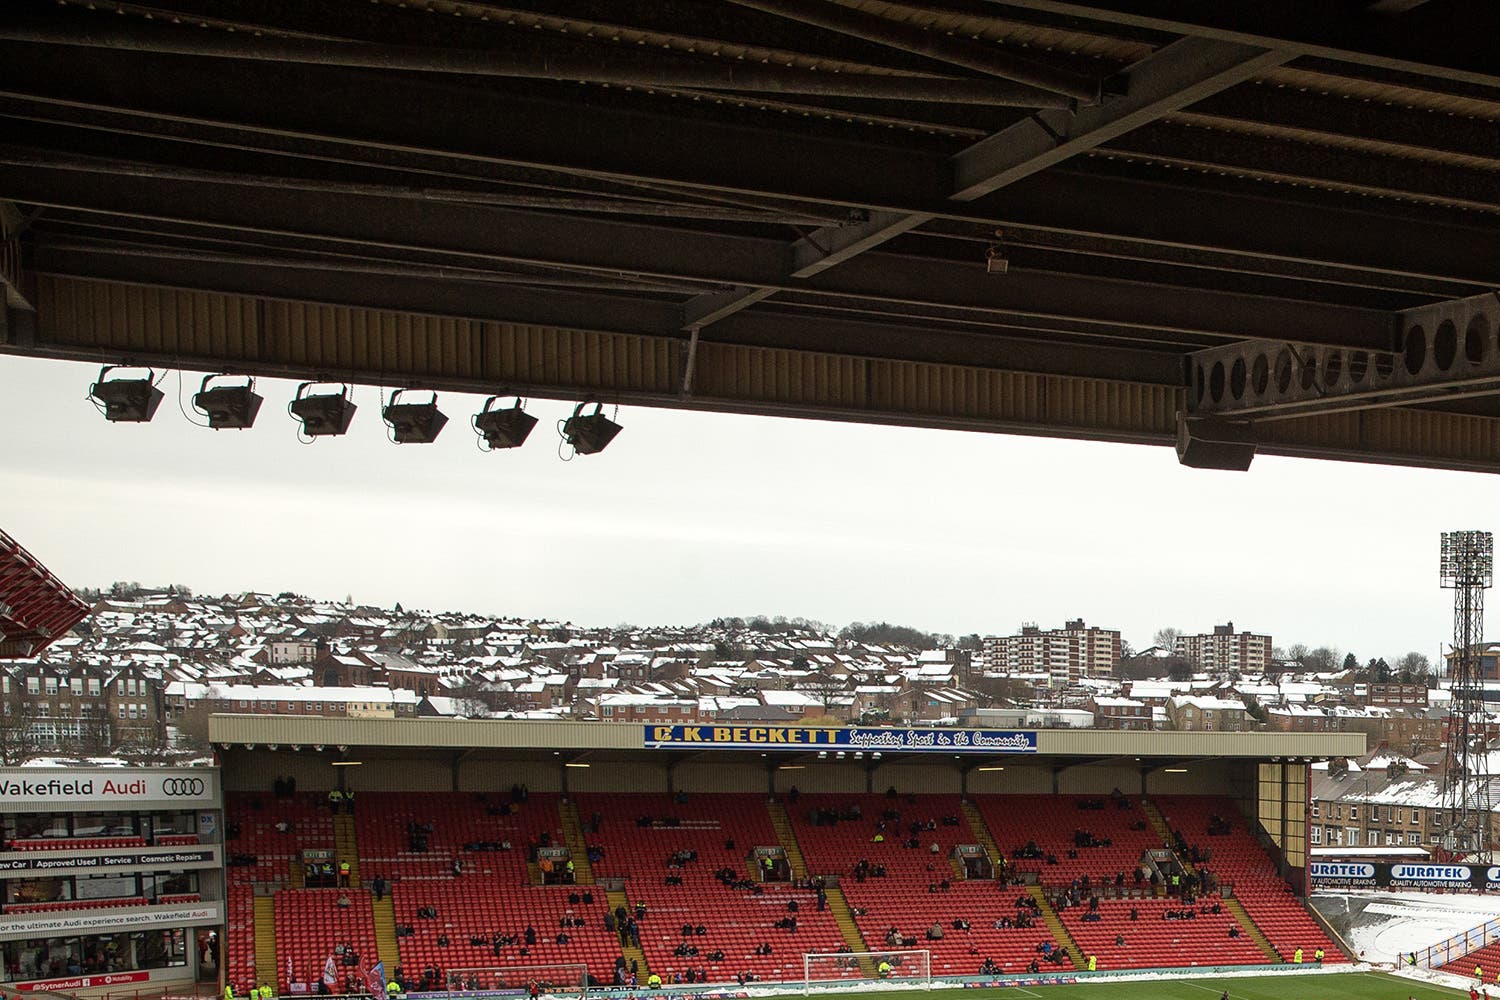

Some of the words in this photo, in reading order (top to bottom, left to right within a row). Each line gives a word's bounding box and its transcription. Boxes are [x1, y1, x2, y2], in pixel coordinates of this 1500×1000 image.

[850, 730, 903, 747] Supporting
[907, 731, 934, 747] Sport
[937, 732, 950, 744] in
[954, 732, 969, 745] the
[973, 732, 1029, 750] Community
[102, 780, 146, 794] Audi
[36, 859, 75, 868] Approved
[77, 858, 97, 866] Used
[104, 857, 132, 865] Service
[141, 855, 174, 863] Cosmetic
[175, 853, 201, 862] Repairs
[1311, 865, 1367, 876] URATEK
[1399, 867, 1463, 878] JURATEK
[1317, 877, 1351, 885] AUTOMOTIVE
[1390, 879, 1412, 887] QUALITY
[1413, 880, 1448, 888] AUTOMOTIVE
[27, 922, 61, 930] ultimate
[83, 918, 124, 927] experience
[154, 912, 190, 921] Wakefield
[33, 980, 81, 991] @SytnerAudi
